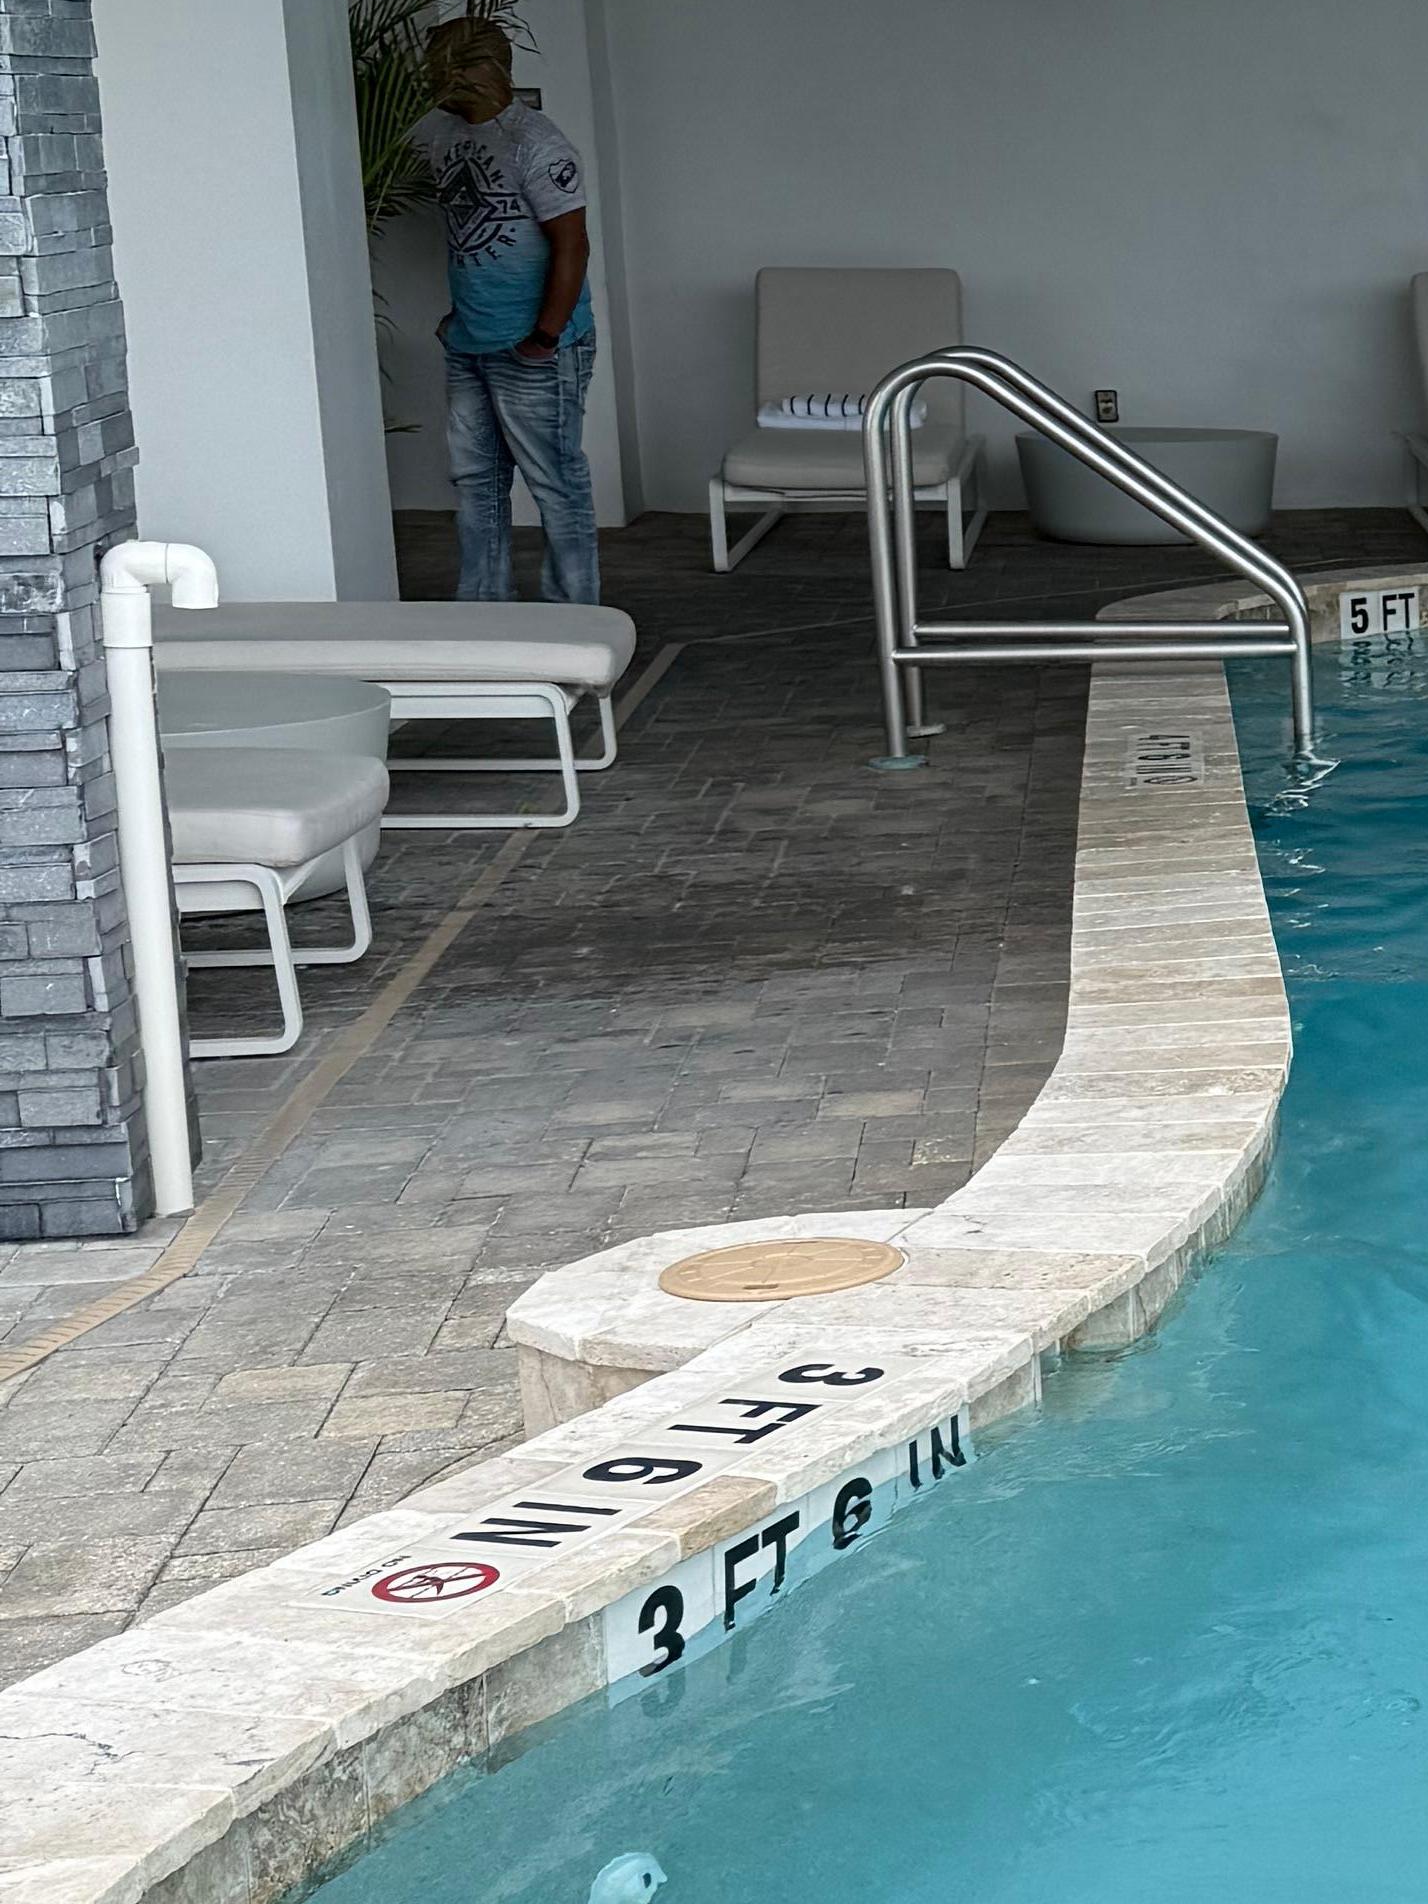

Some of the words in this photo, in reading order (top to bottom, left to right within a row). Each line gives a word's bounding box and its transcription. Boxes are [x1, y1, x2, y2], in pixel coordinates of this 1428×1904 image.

[496, 199, 522, 214] 74
[1350, 597, 1369, 634] 5
[1382, 592, 1415, 632] FT
[778, 1363, 884, 1386] 3
[667, 1398, 822, 1444] FT
[582, 1456, 703, 1485] 6
[450, 1501, 622, 1548] IN
[638, 1585, 685, 1677] 3
[724, 1510, 800, 1632] FT
[832, 1477, 873, 1550] 6
[908, 1414, 966, 1488] IN
